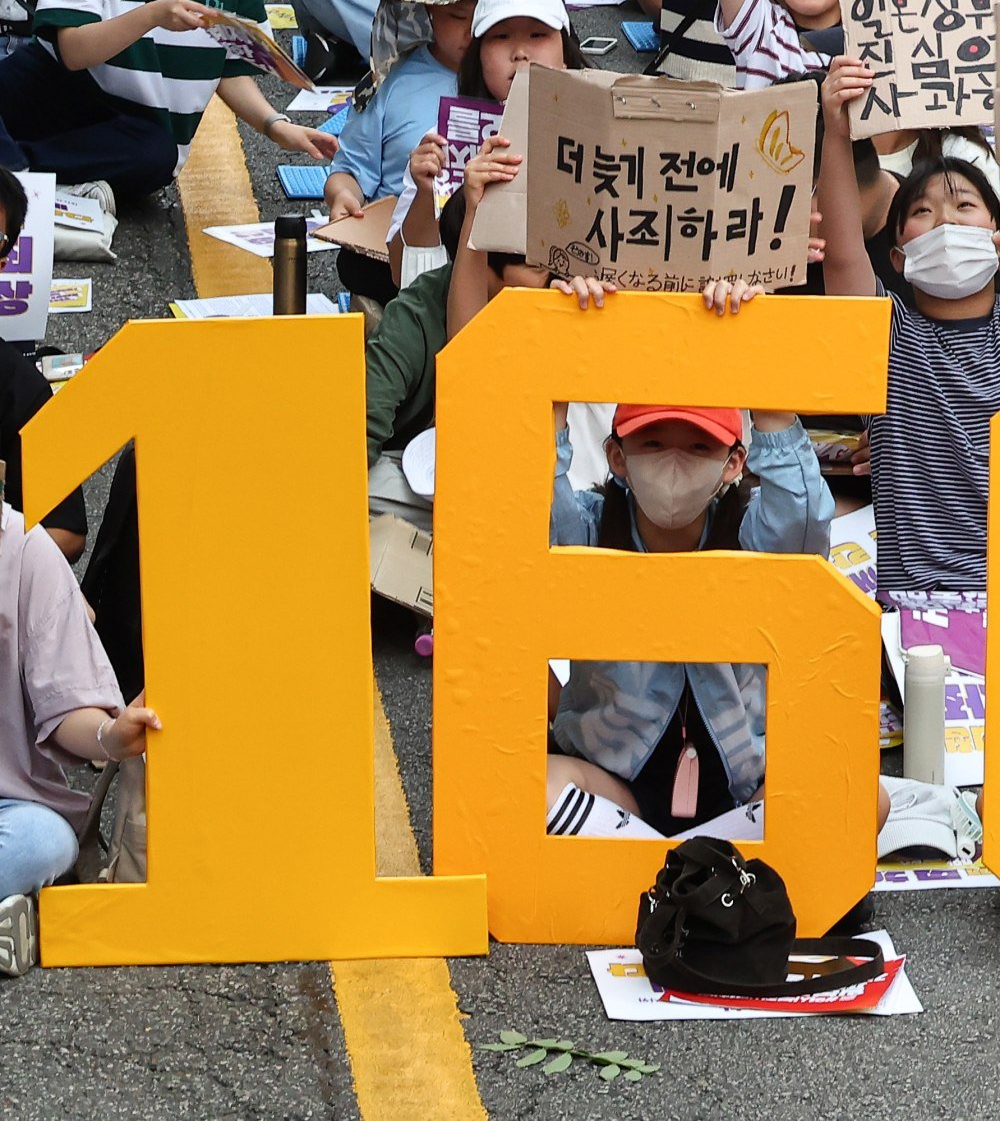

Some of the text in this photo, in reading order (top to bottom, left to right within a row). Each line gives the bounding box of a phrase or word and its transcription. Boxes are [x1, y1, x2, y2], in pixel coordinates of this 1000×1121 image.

[557, 134, 585, 184] 더
[592, 144, 646, 200] 늦기
[658, 142, 742, 193] 전에
[585, 184, 797, 264] 사죄하라!
